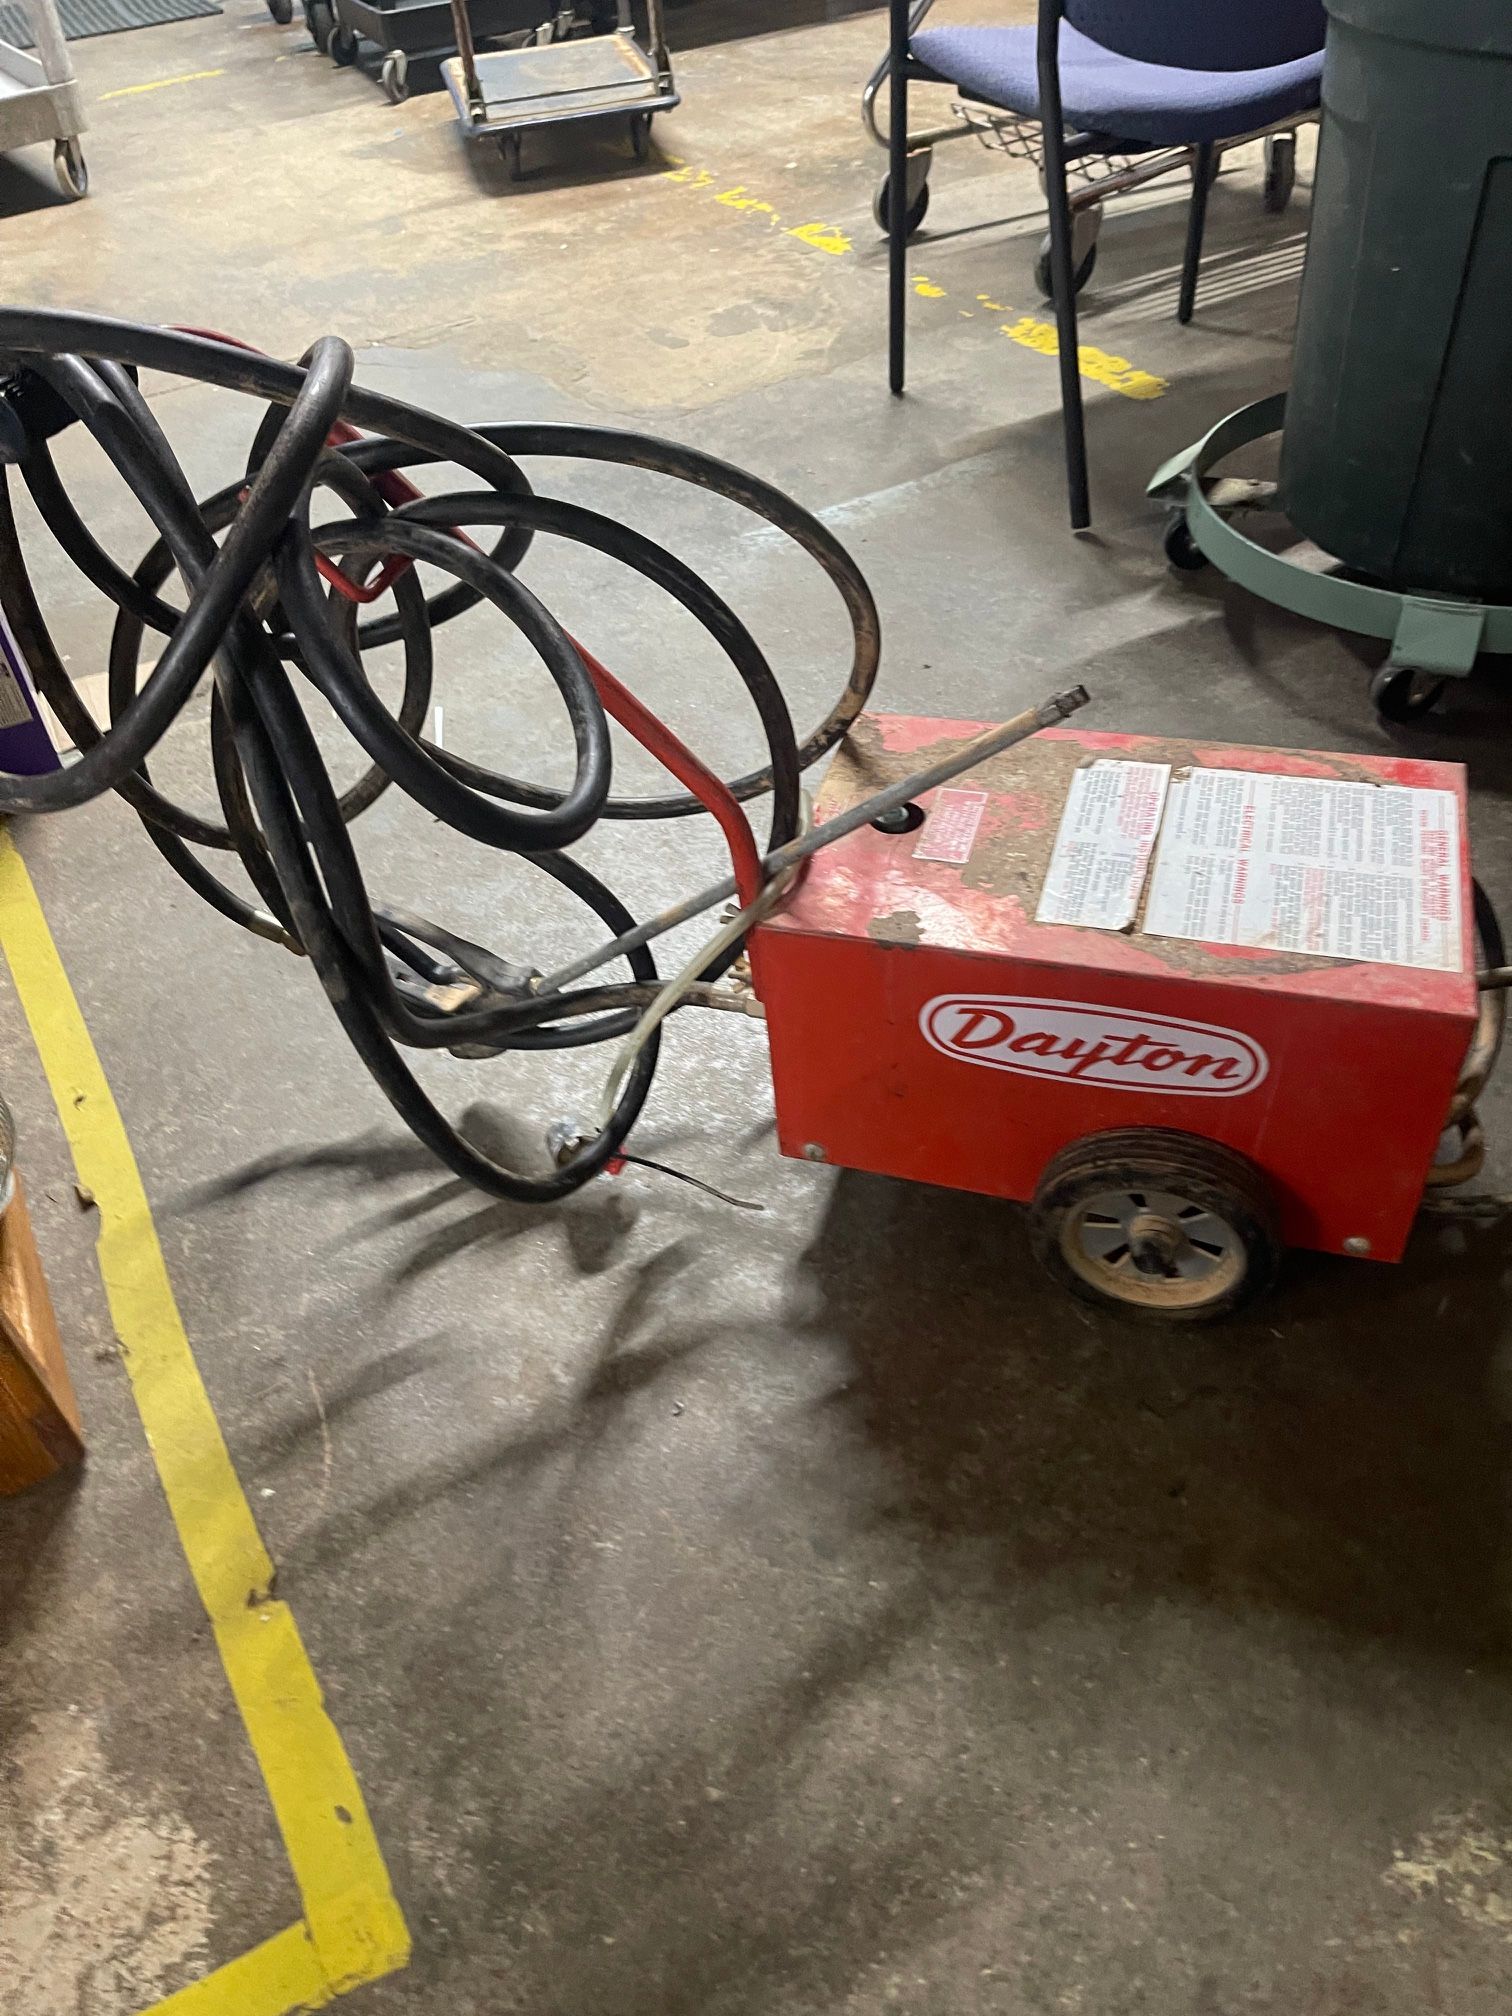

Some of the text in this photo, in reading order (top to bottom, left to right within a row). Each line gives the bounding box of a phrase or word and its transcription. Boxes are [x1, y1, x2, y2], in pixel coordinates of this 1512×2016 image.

[1231, 804, 1256, 904] ELECTRICAL WARNINGS
[1438, 830, 1452, 921] GENERAL WARNINGS
[949, 1007, 1241, 1080] Dayton
